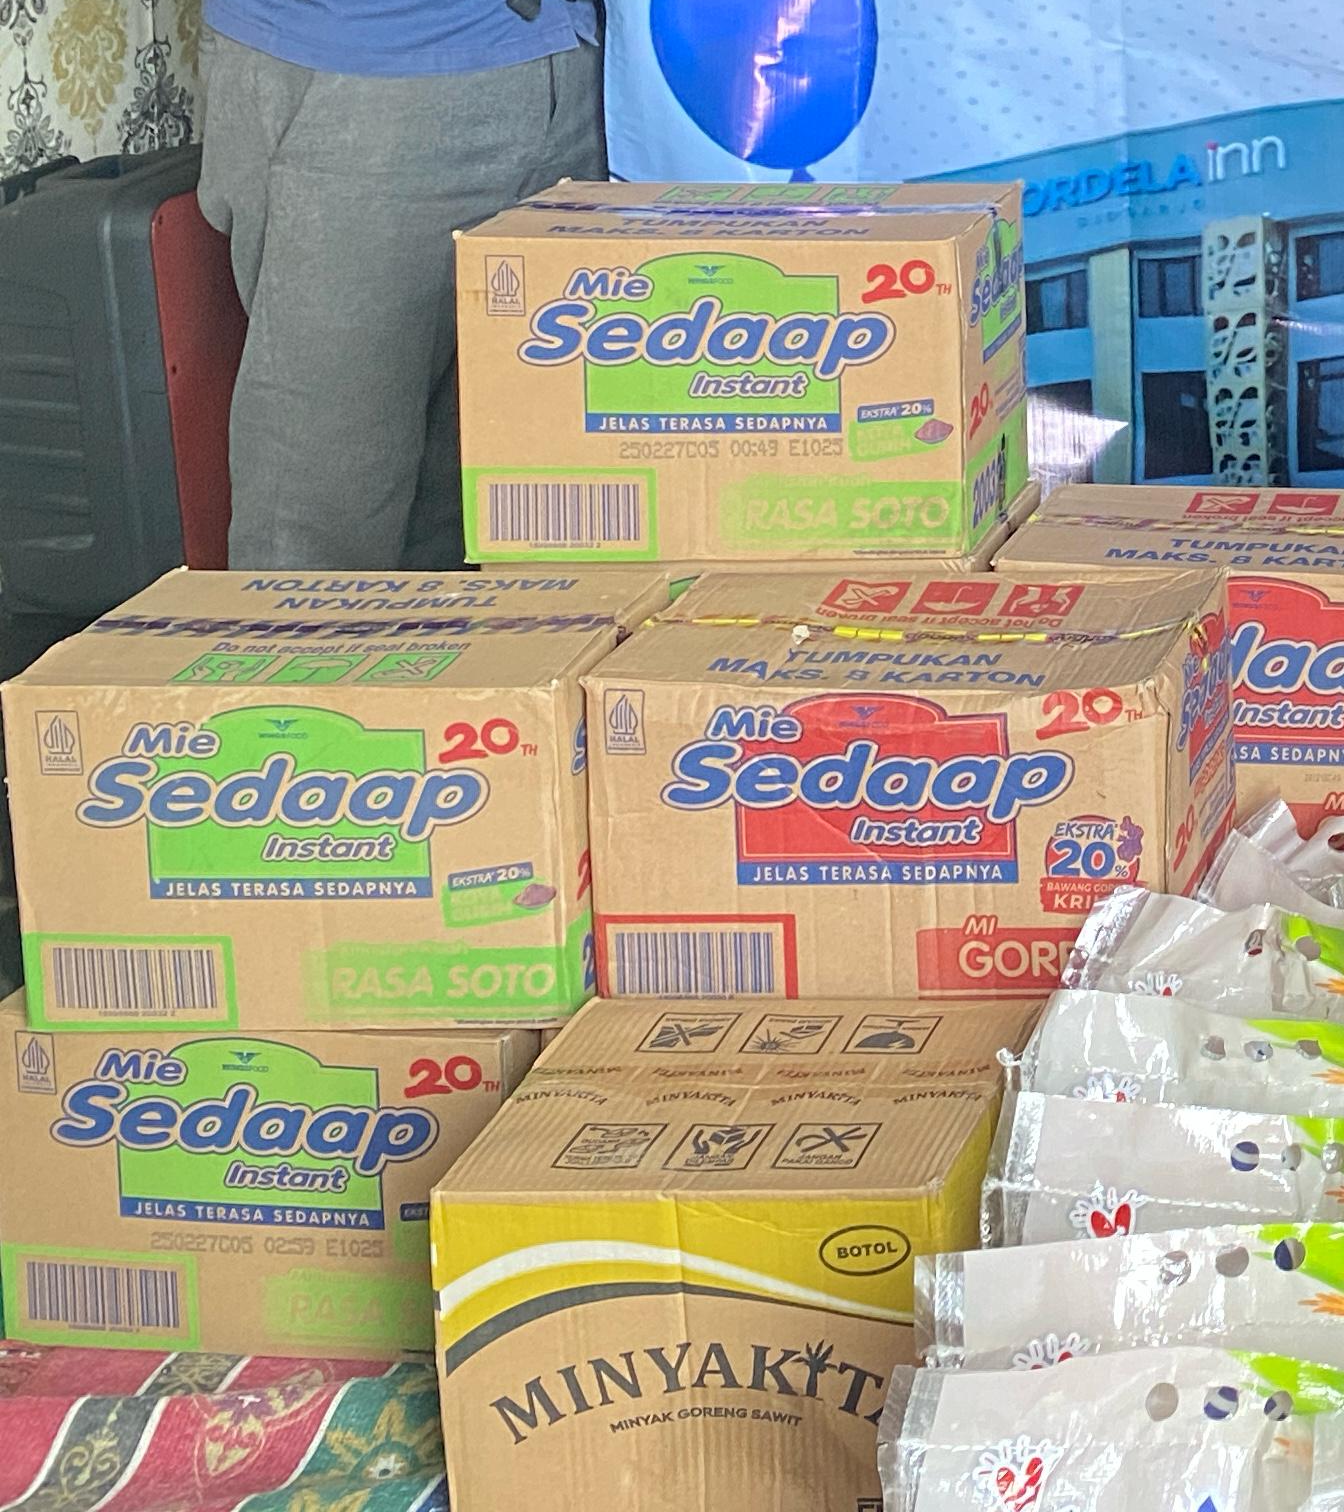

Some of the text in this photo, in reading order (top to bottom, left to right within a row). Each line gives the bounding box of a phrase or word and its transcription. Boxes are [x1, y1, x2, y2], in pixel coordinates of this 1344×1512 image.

[571, 272, 650, 298] Mie
[522, 302, 891, 374] Sedaap
[690, 374, 806, 395] Instant
[600, 416, 827, 432] JELAS TERASA SEDAPNYA
[730, 439, 778, 457] 00:49
[789, 439, 843, 457] E1025
[747, 497, 948, 530] RASA SOTO
[1105, 548, 1210, 563] MAKS.
[1231, 556, 1251, 565] 8
[242, 578, 410, 592] KARTON
[462, 578, 579, 590] MAKS.
[274, 595, 499, 609] TUMPUKAN
[785, 648, 1001, 667] TUMPUKAN
[881, 671, 1046, 687] KARTON
[709, 710, 800, 739] Mie
[129, 726, 215, 754] Mie
[665, 743, 1068, 818] Sedaap
[82, 759, 484, 838] Sedaap
[852, 816, 981, 845] Instant
[265, 836, 394, 859] Instant
[753, 864, 1002, 882] JELAS TERASA SEDAPNYA
[165, 881, 418, 897] JELAS TERASA SEDAPNYA
[965, 918, 996, 935] MI
[959, 941, 1072, 978] GOR
[331, 964, 555, 998] RASA SOTO
[101, 1054, 183, 1082] Mie
[771, 1090, 861, 1106] MINYAKITA
[53, 1085, 432, 1172] Sedaap
[229, 1165, 346, 1189] Instant
[135, 1201, 370, 1227] JELAS TERASA SEDAPNYA
[837, 1241, 897, 1258] BOTOL
[489, 1340, 885, 1444] MINYAKIT
[609, 1407, 803, 1433] MINYAK GORENG SAWIT
